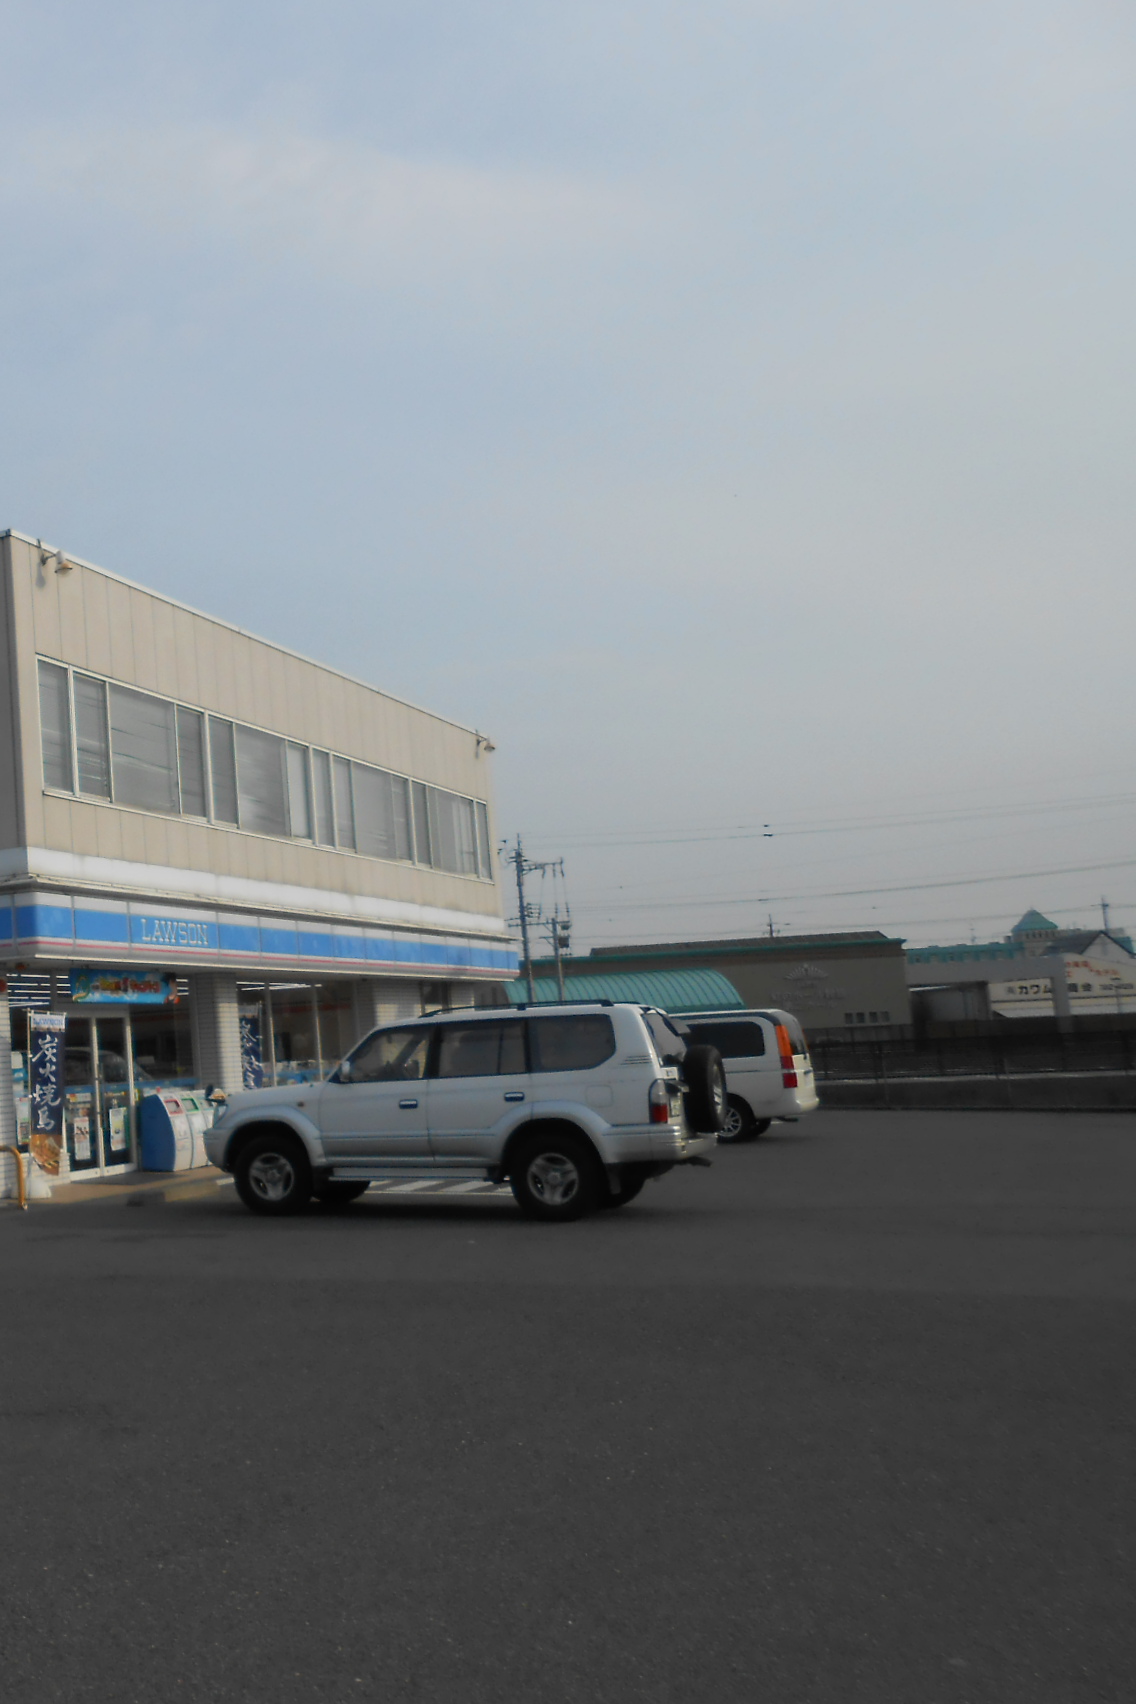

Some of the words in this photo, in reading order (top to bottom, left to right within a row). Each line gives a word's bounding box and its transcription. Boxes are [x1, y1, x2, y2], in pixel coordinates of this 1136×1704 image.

[140, 918, 209, 945] LAWSON
[31, 1033, 62, 1131] 炭火焼鳥
